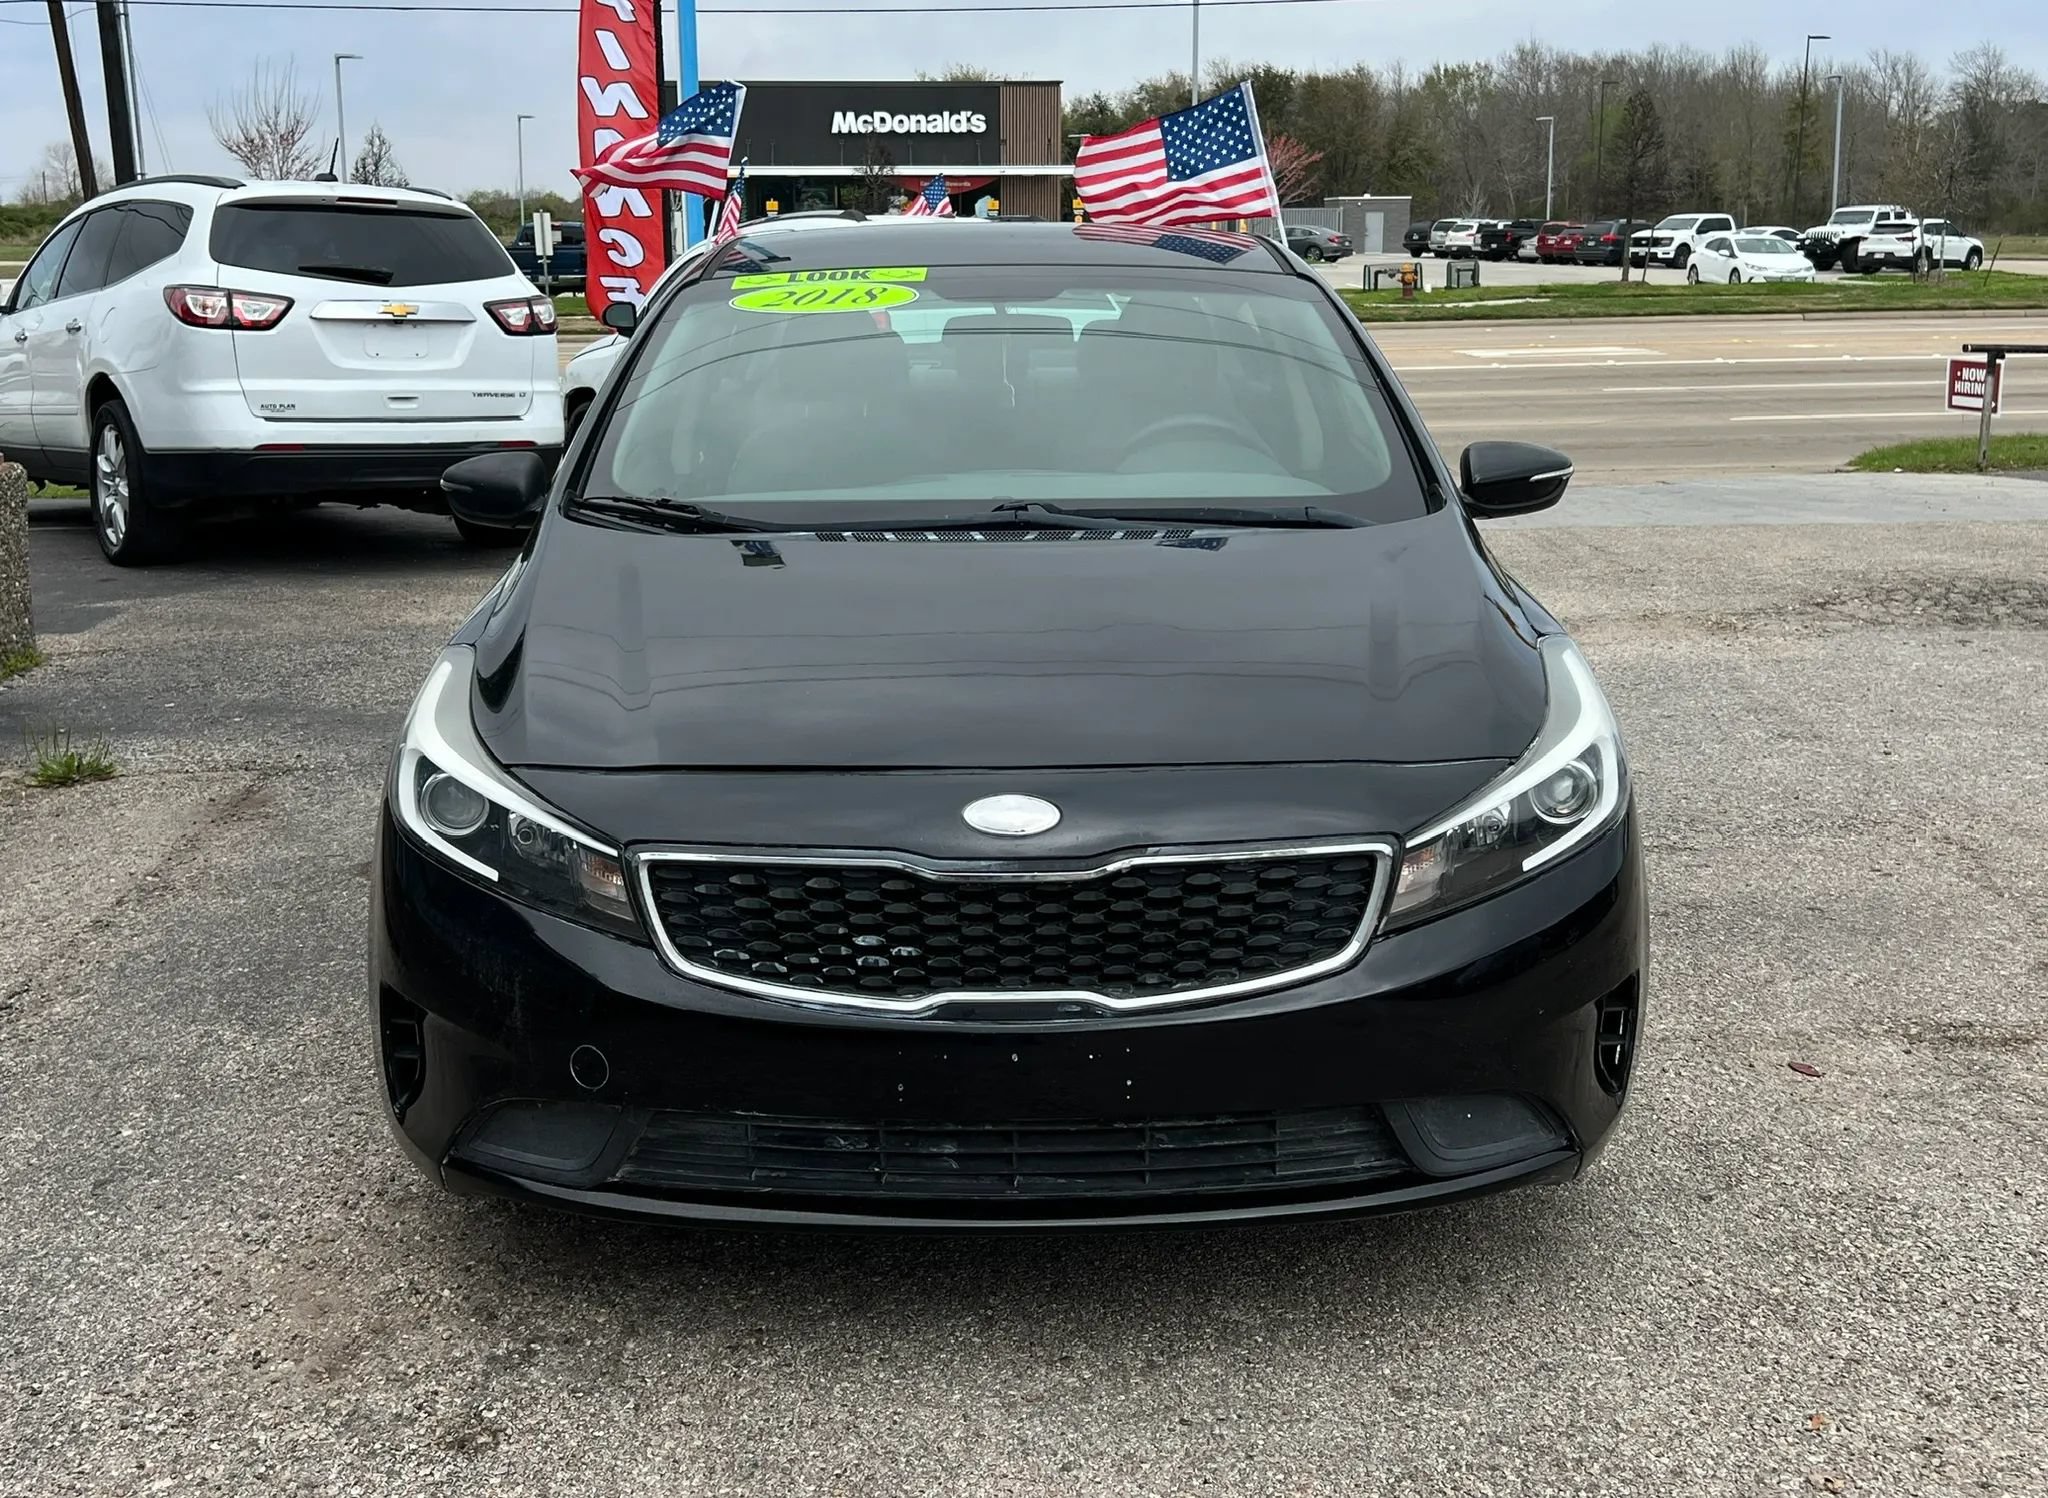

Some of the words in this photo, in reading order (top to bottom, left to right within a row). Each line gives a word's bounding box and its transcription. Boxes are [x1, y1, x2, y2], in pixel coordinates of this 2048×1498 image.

[831, 111, 987, 134] McDonald's
[788, 270, 872, 283] LOOK
[761, 287, 888, 307] 2018
[1962, 367, 1986, 382] NOW
